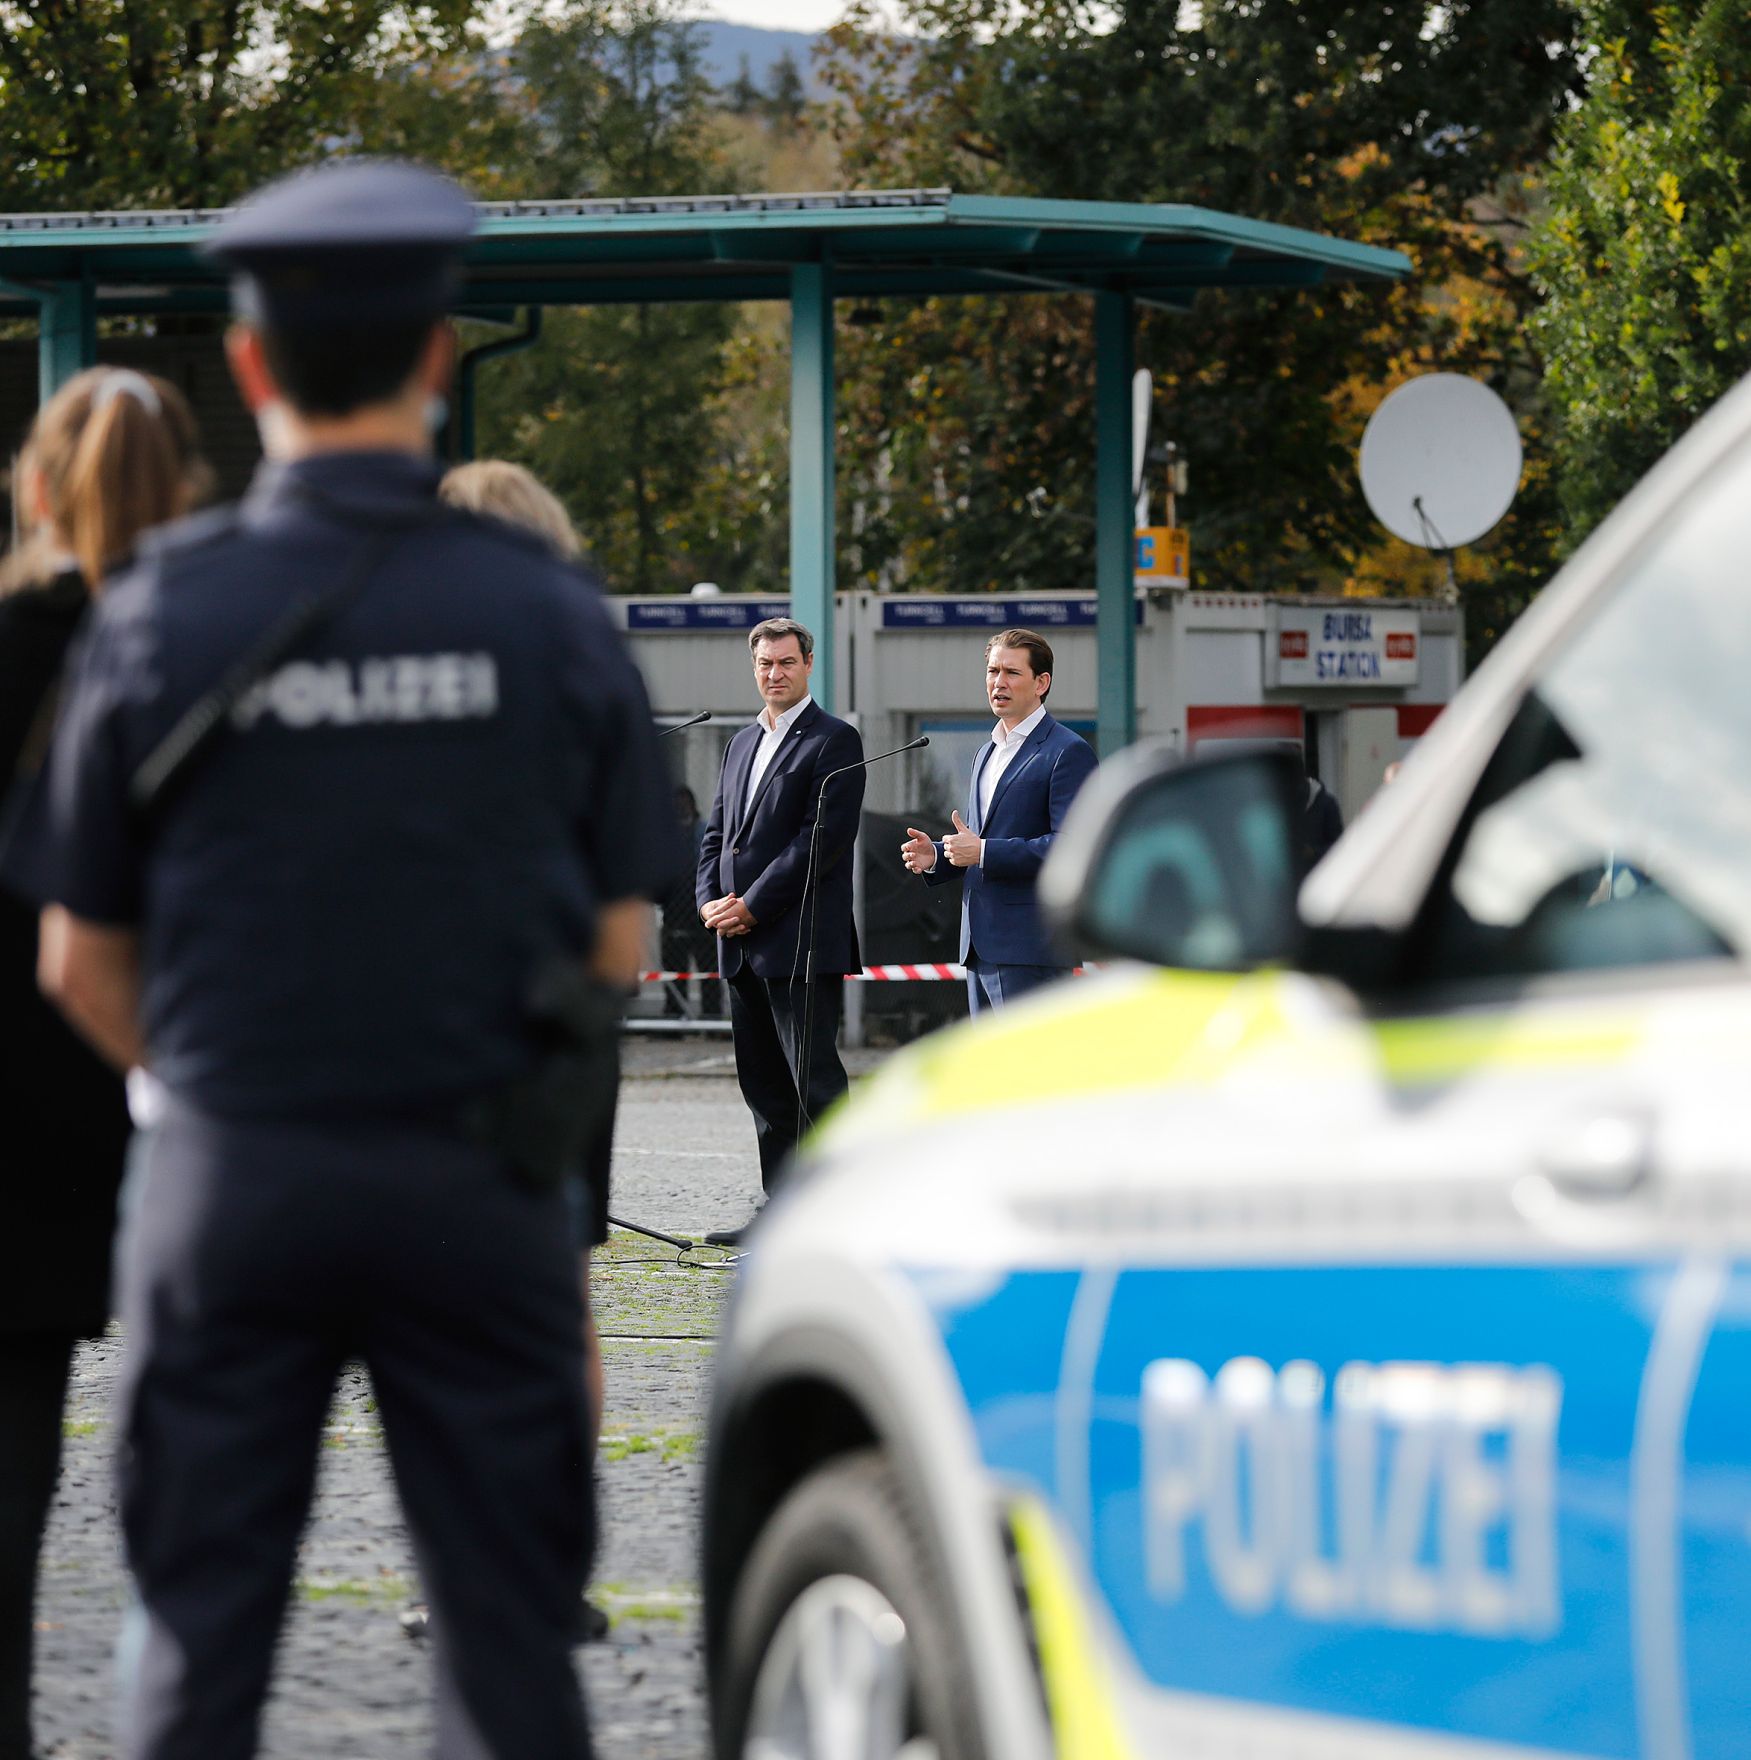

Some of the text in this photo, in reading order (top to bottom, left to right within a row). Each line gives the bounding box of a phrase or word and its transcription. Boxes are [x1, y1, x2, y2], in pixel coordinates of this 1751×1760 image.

[1323, 613, 1373, 641] BURSA
[1316, 651, 1381, 678] STATION
[1141, 1359, 1563, 1637] POLIZEI
